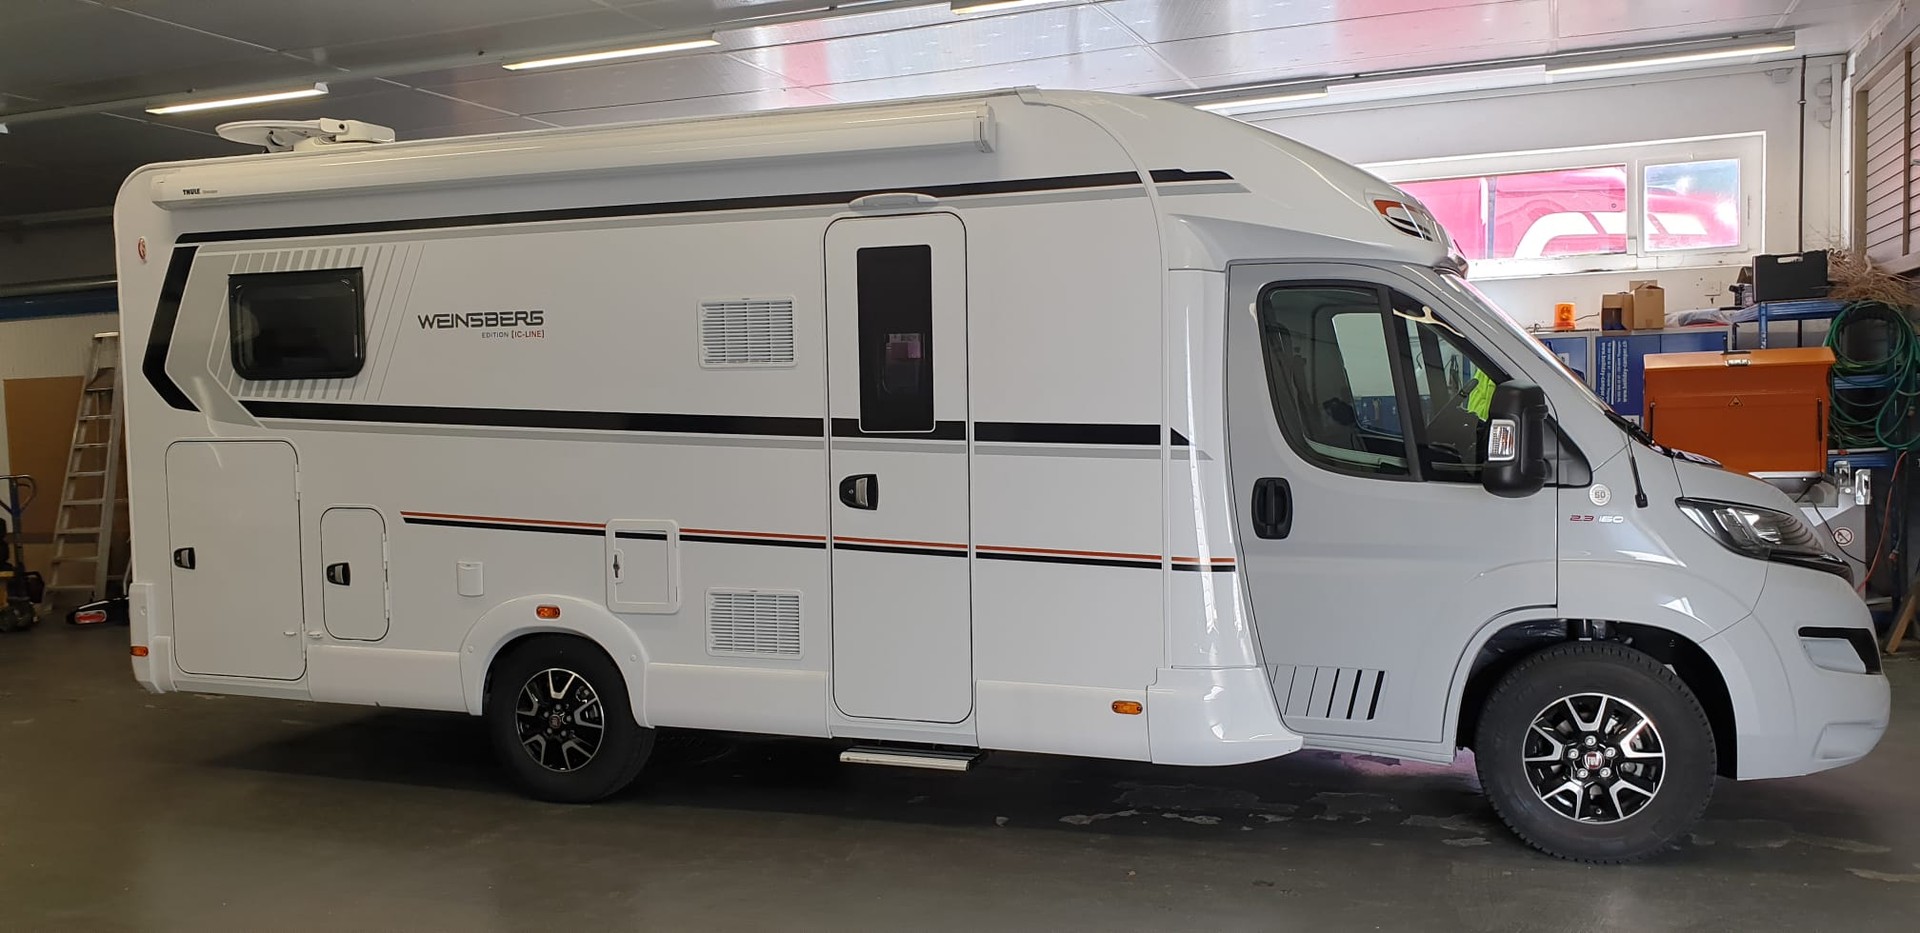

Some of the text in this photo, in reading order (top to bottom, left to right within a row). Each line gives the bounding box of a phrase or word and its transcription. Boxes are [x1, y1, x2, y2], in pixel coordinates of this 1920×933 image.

[417, 310, 544, 329] WEINSBERG
[481, 330, 545, 339] EDITION [IC-LINE]
